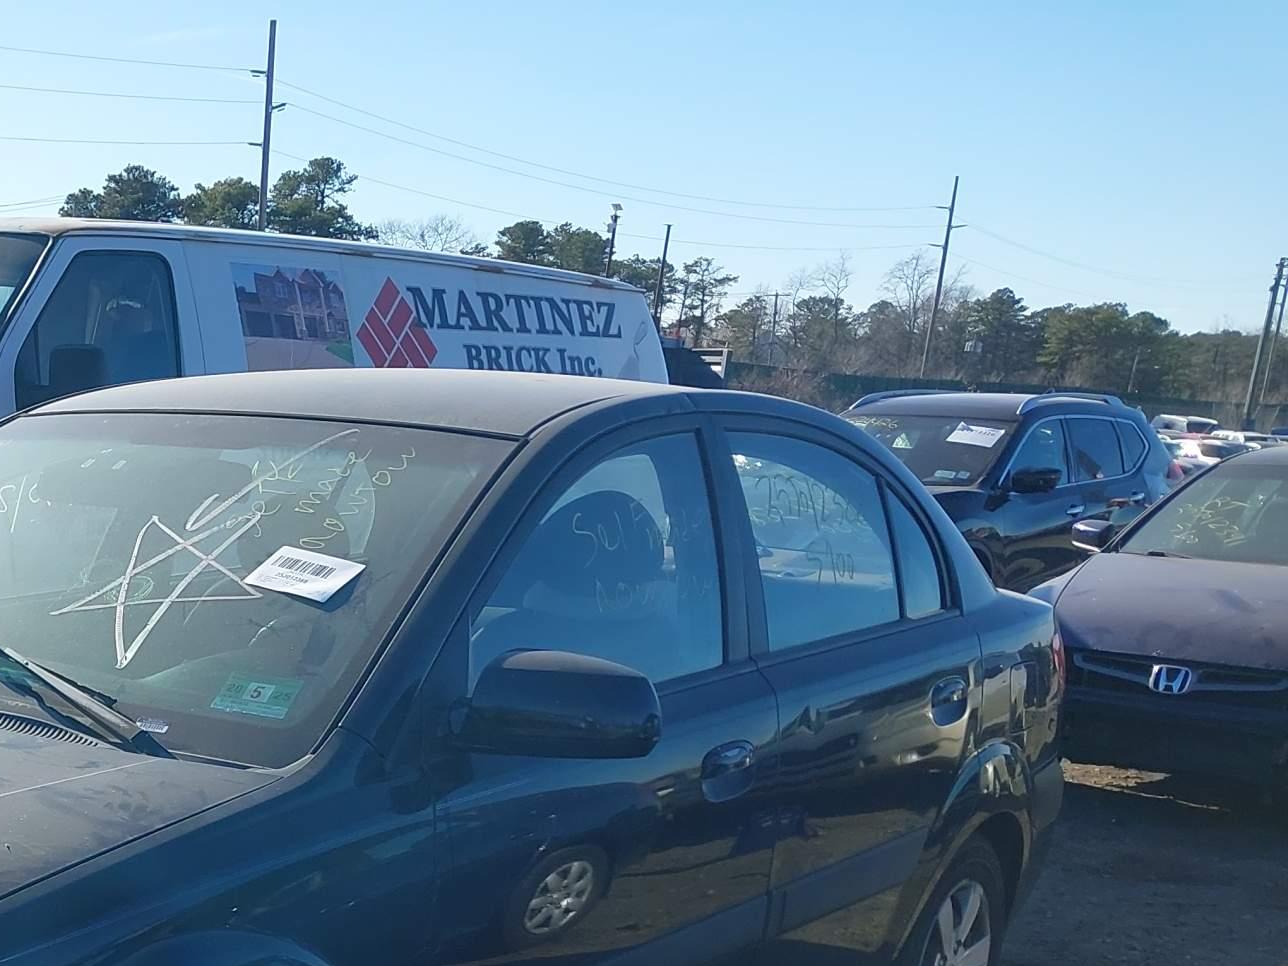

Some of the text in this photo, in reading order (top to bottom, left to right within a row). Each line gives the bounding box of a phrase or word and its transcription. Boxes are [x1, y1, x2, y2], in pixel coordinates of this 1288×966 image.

[406, 286, 622, 339] MARTINEZ
[463, 343, 603, 378] BRICK Inc.
